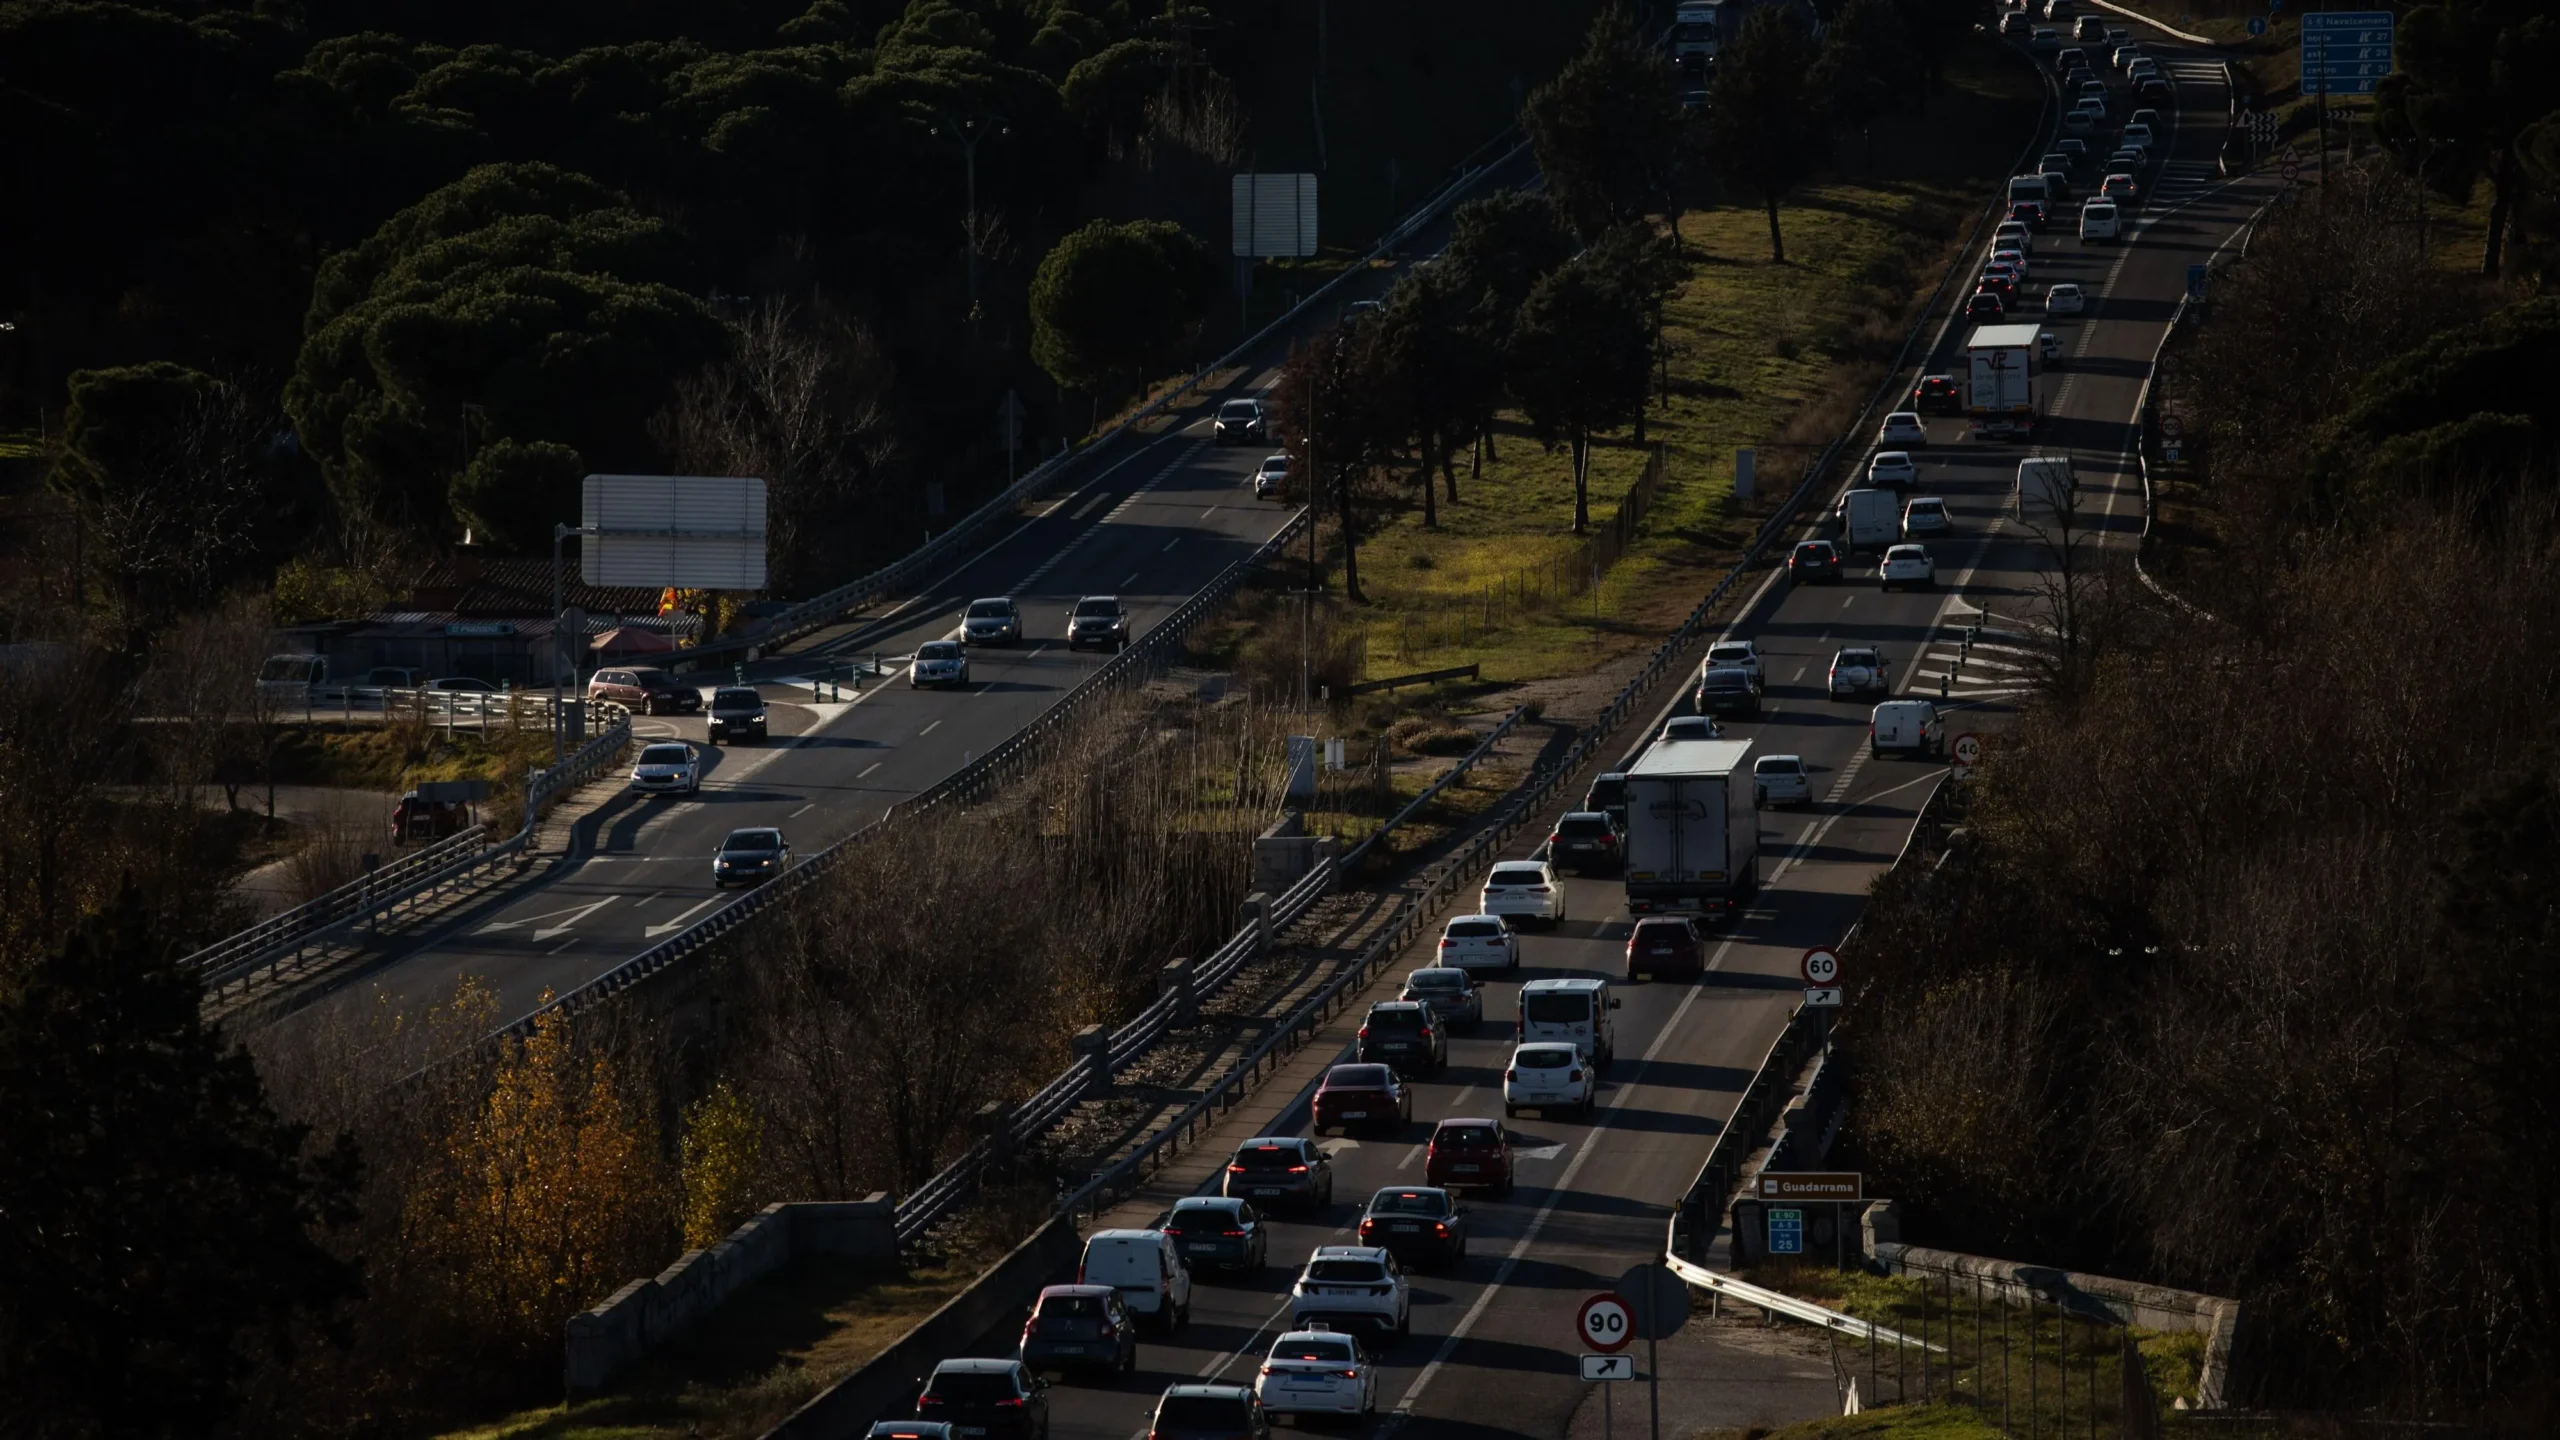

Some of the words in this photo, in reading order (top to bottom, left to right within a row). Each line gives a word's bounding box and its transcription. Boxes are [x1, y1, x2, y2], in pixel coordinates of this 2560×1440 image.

[2326, 17, 2388, 25] Navalcarnero
[2376, 32, 2388, 40] 27
[1958, 743, 1978, 755] 40
[1810, 960, 1833, 973] 60
[1782, 1181, 1854, 1193] Guadarrama
[1775, 1211, 1795, 1219] E-90
[1778, 1221, 1793, 1229] A-5
[1777, 1240, 1793, 1250] 25
[1589, 1313, 1623, 1333] 90
